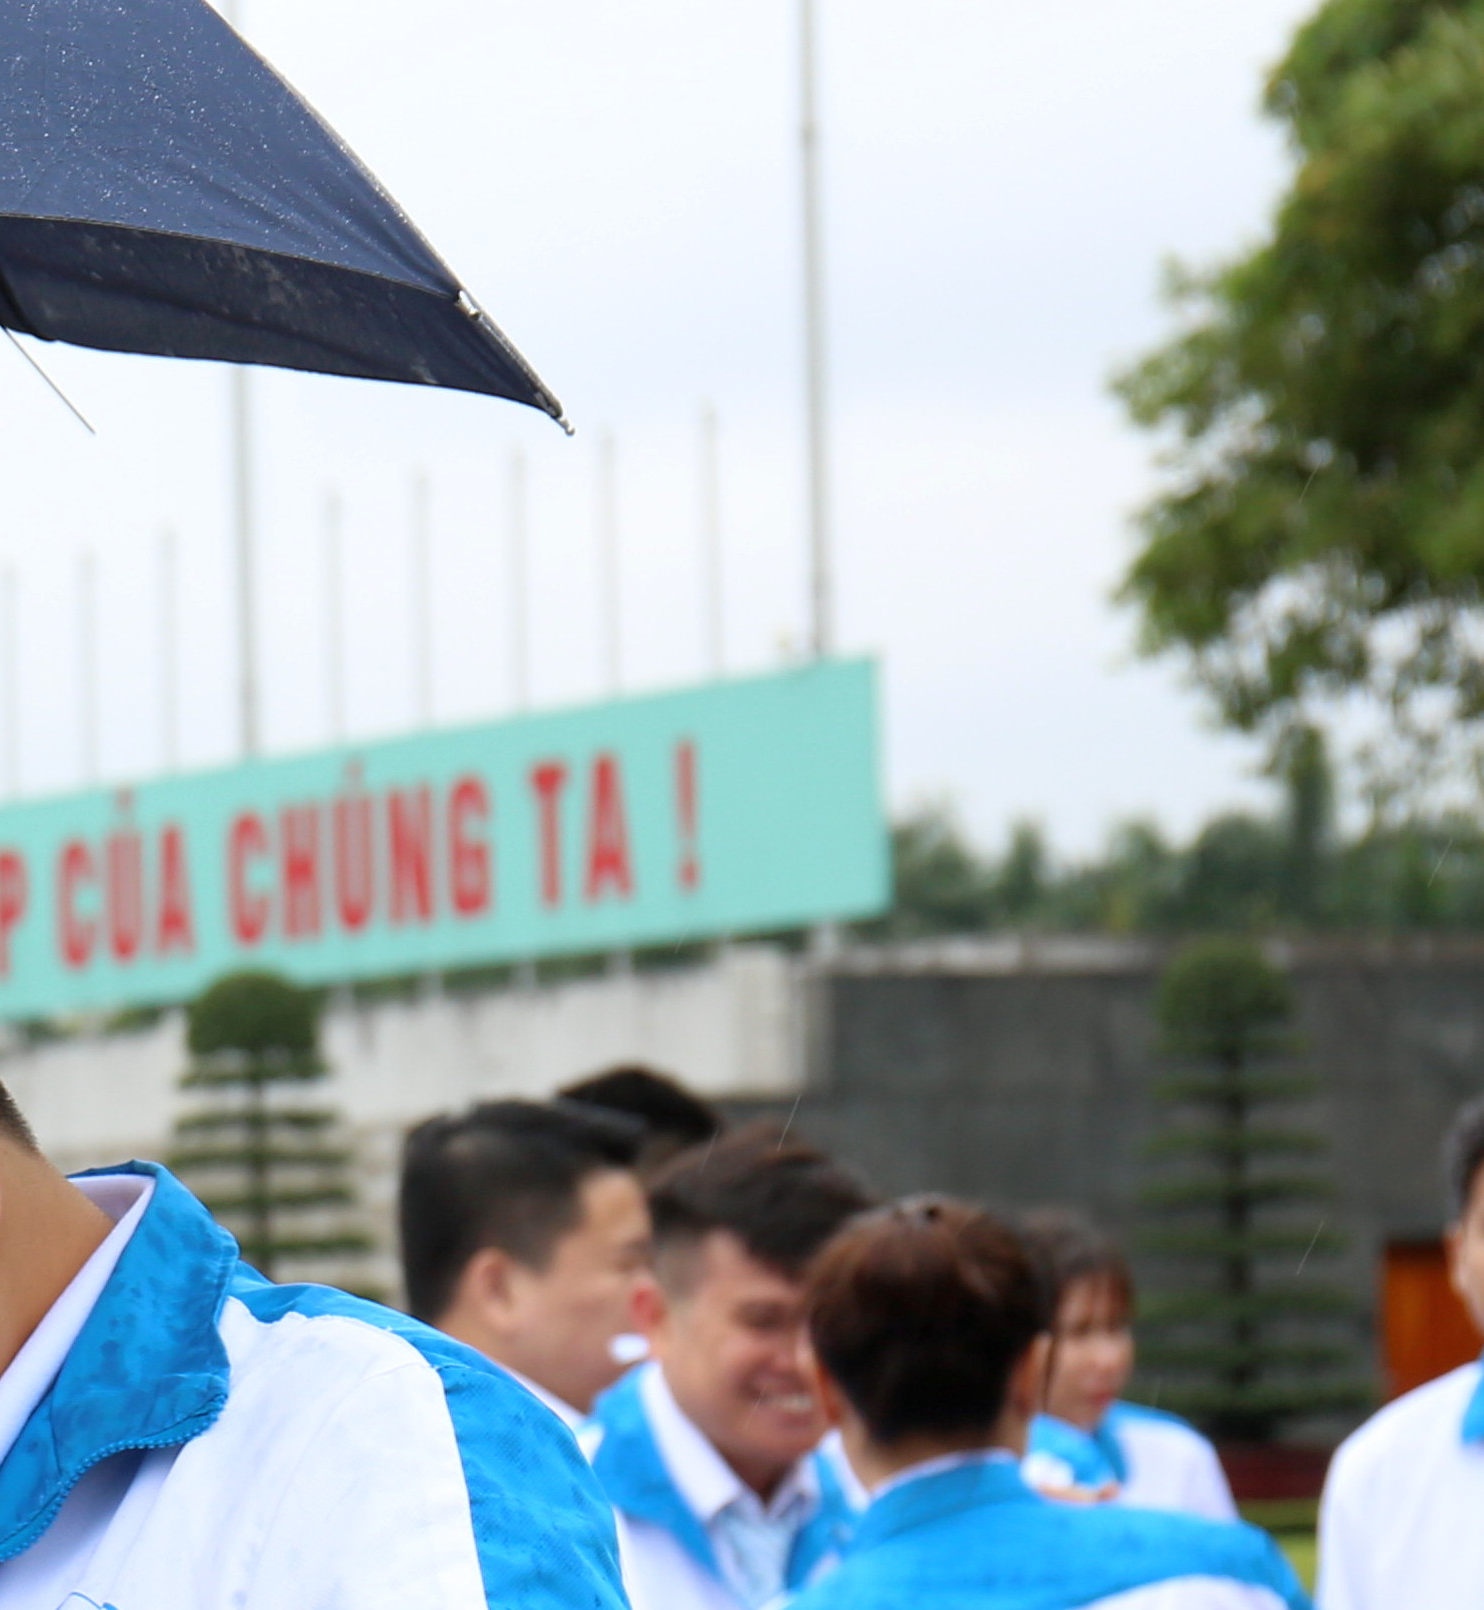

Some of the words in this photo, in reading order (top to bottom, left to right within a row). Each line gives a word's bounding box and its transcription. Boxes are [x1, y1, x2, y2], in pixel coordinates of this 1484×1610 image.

[56, 785, 195, 972] CỦA
[529, 748, 634, 911] TA
[676, 738, 700, 893] !
